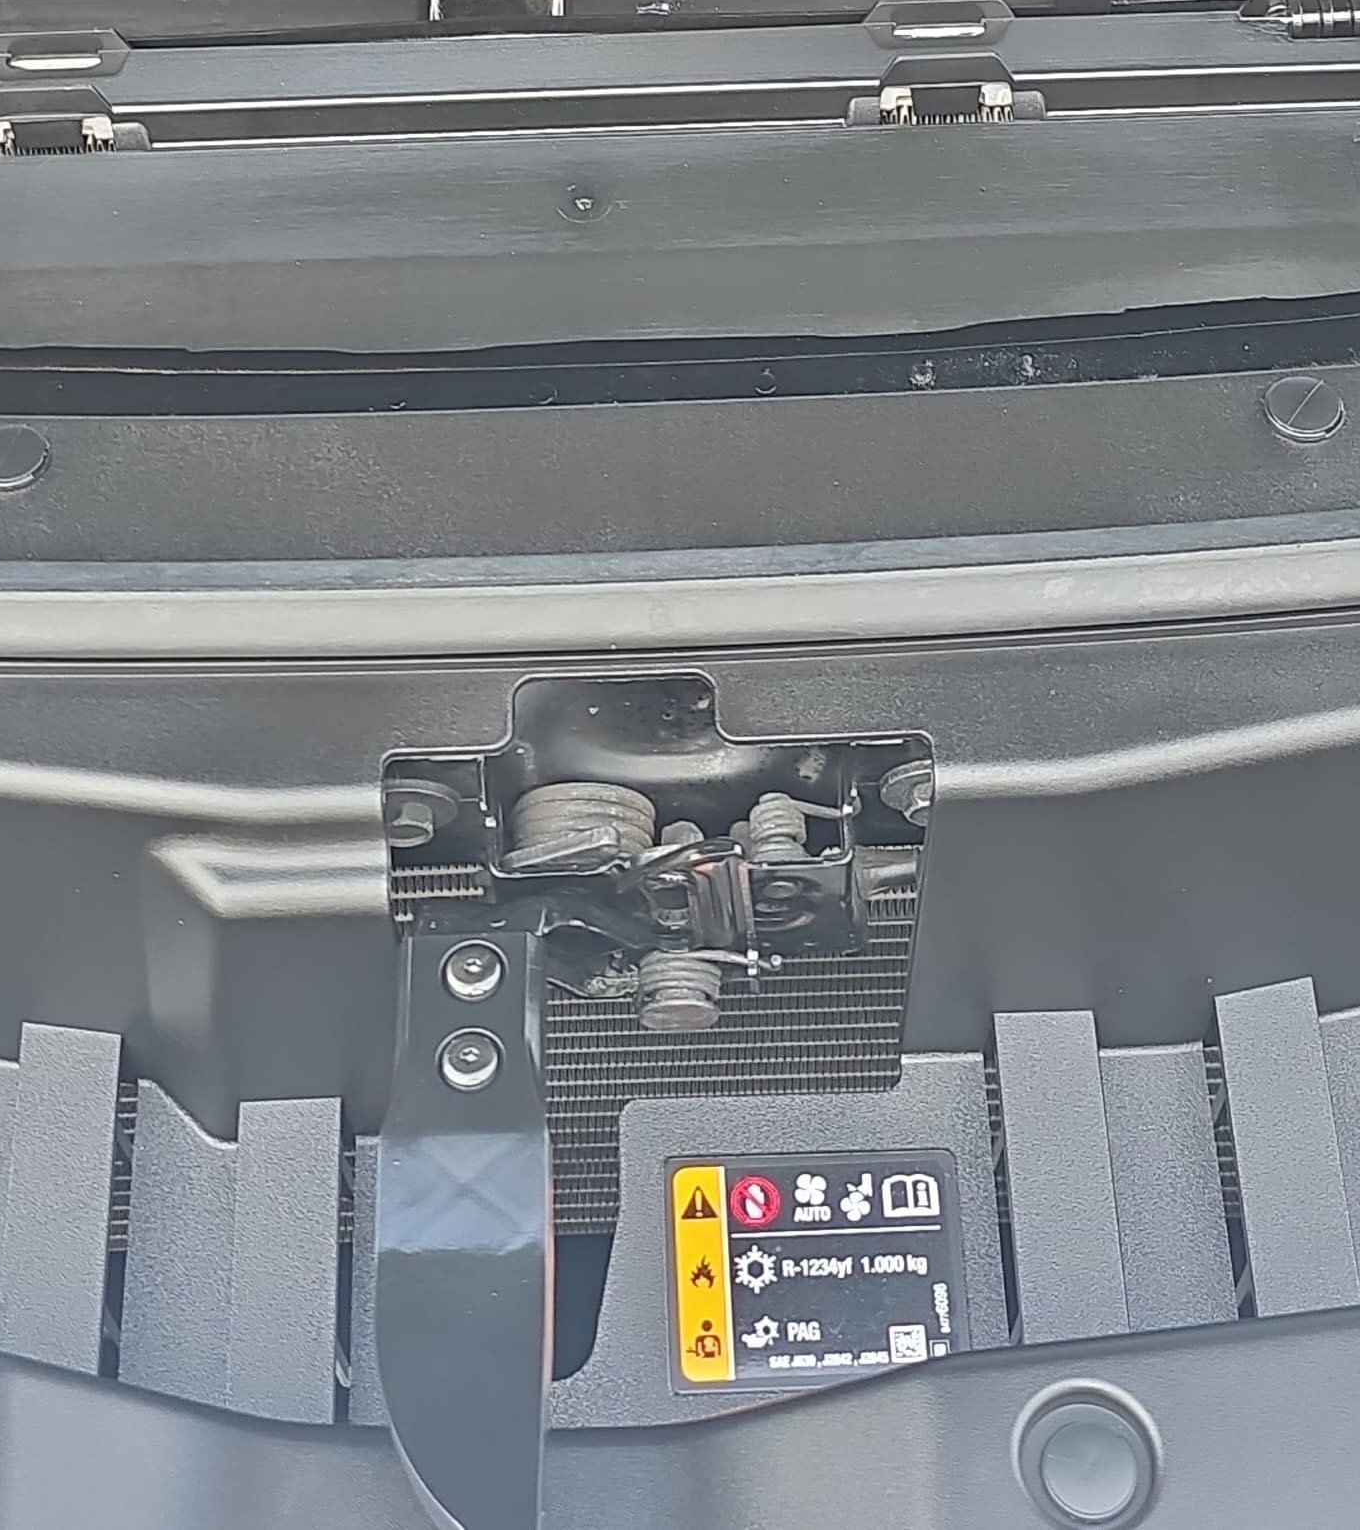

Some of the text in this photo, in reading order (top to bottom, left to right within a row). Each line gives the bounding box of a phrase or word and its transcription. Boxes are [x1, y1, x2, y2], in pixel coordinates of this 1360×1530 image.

[793, 1205, 831, 1222] AUTO
[782, 1254, 928, 1278] R-1234yf 1.000 kg
[787, 1322, 821, 1342] PAG
